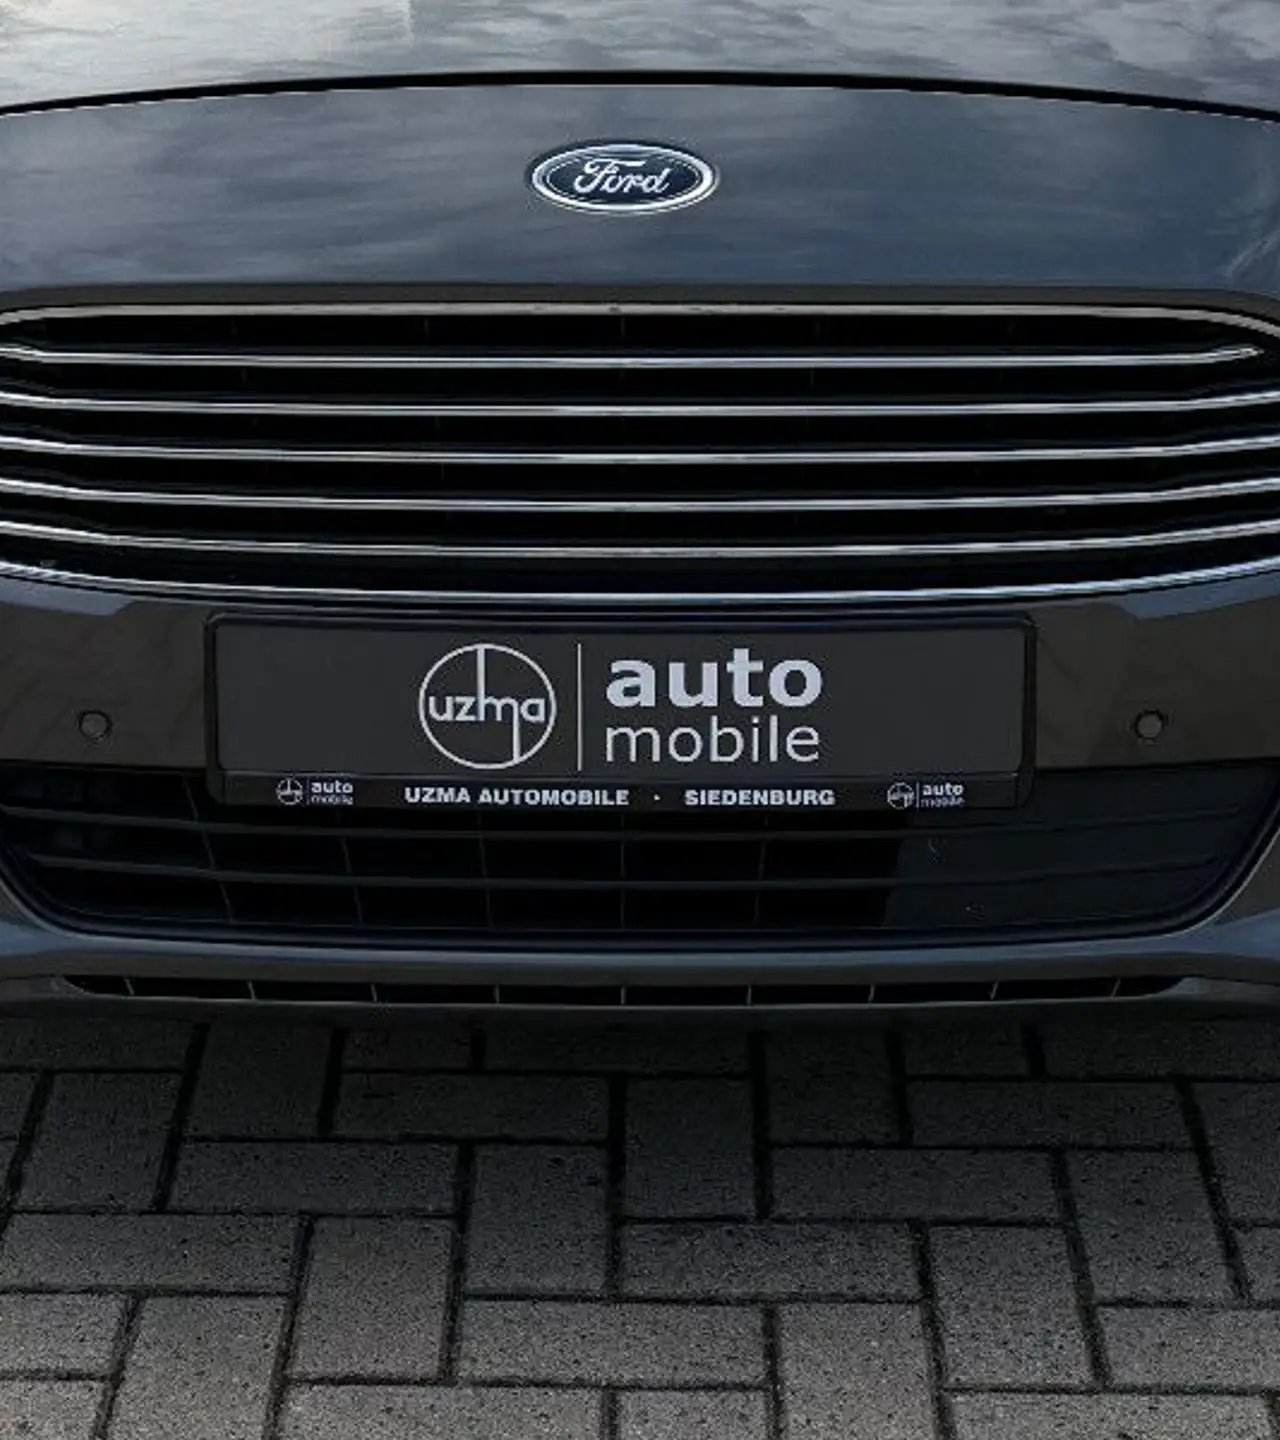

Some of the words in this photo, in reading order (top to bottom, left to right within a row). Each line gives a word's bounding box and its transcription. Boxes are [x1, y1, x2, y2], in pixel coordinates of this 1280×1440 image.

[573, 158, 672, 194] Ford
[606, 647, 823, 707] auto
[606, 714, 820, 763] mobile
[311, 780, 354, 794] auto
[404, 786, 470, 804] UZMA
[477, 788, 629, 806] AUTOMOBILE
[683, 789, 836, 806] SIEDENBURG
[922, 782, 965, 796] auto
